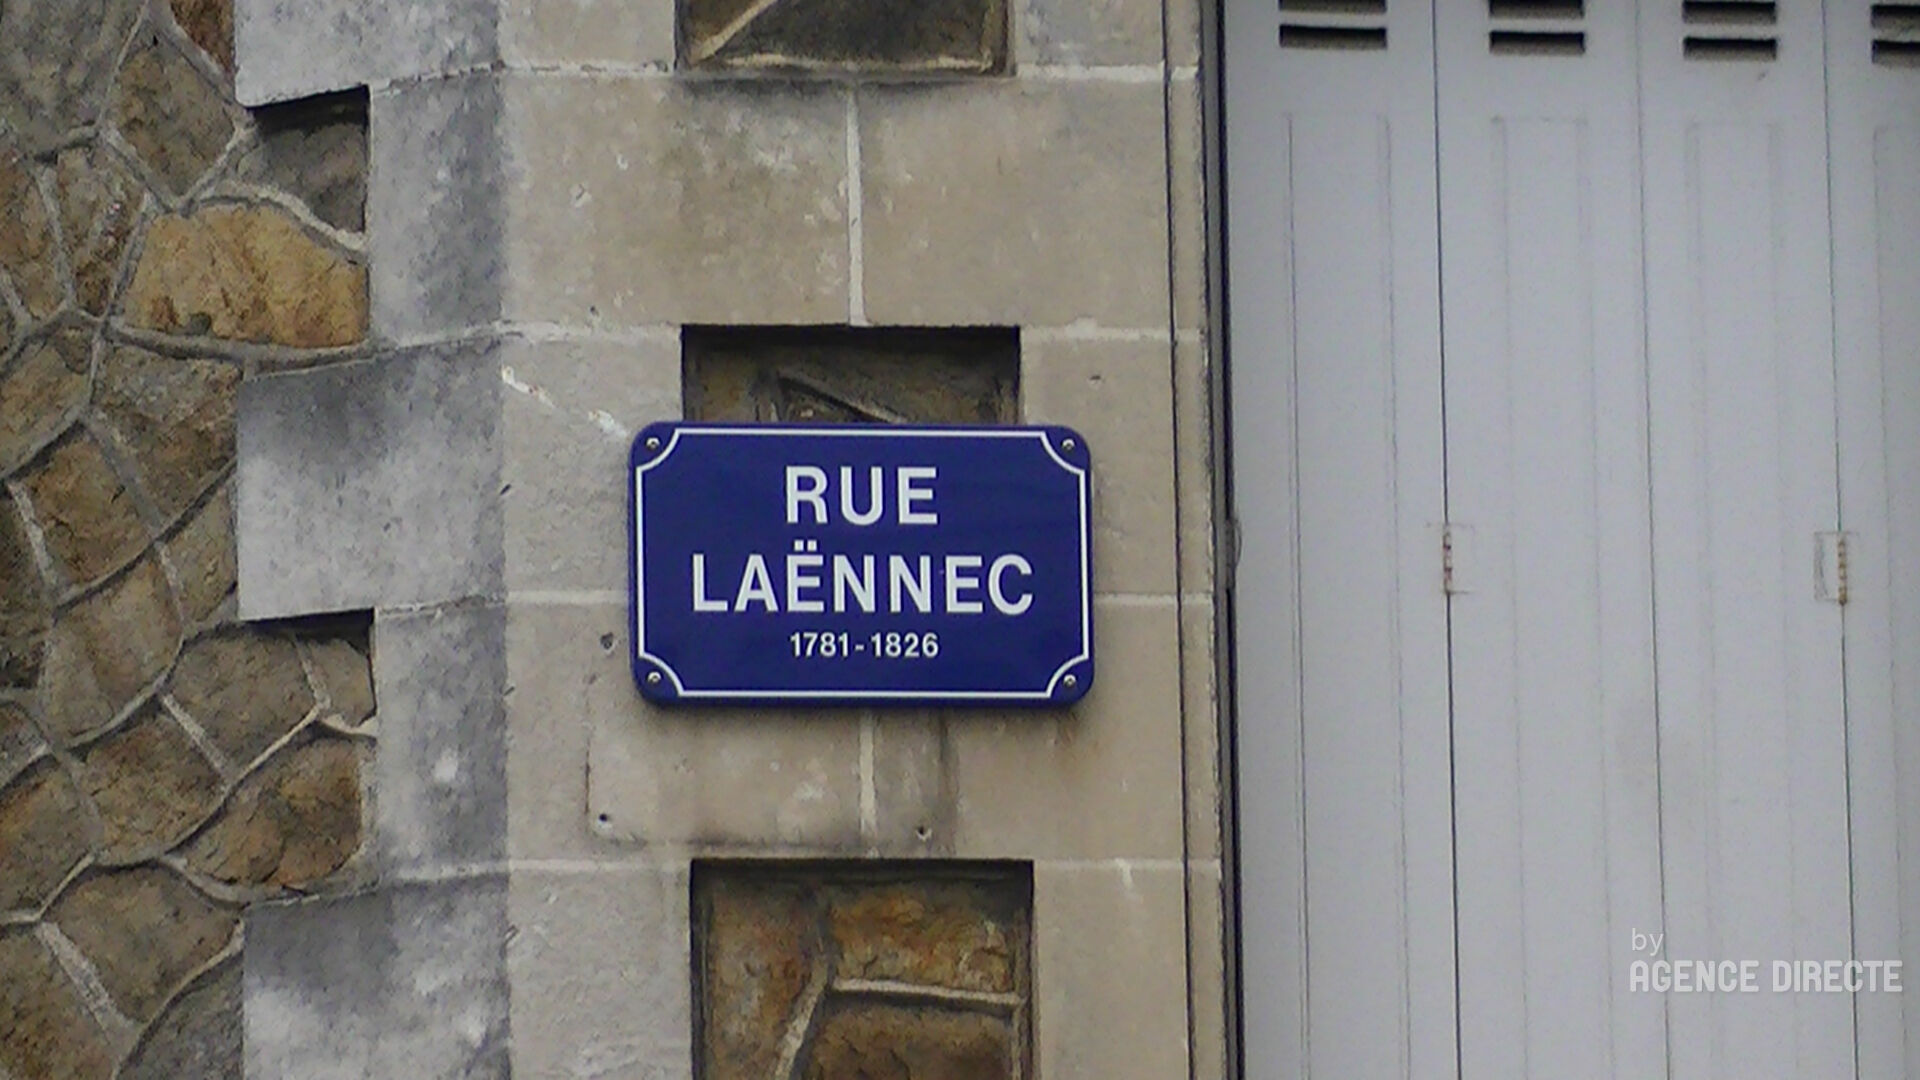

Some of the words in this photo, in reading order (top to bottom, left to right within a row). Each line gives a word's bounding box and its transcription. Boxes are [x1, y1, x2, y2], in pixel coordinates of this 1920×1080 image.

[785, 465, 938, 526] RUE
[692, 539, 1034, 614] LAËNNEC
[790, 632, 939, 658] 1781-1826
